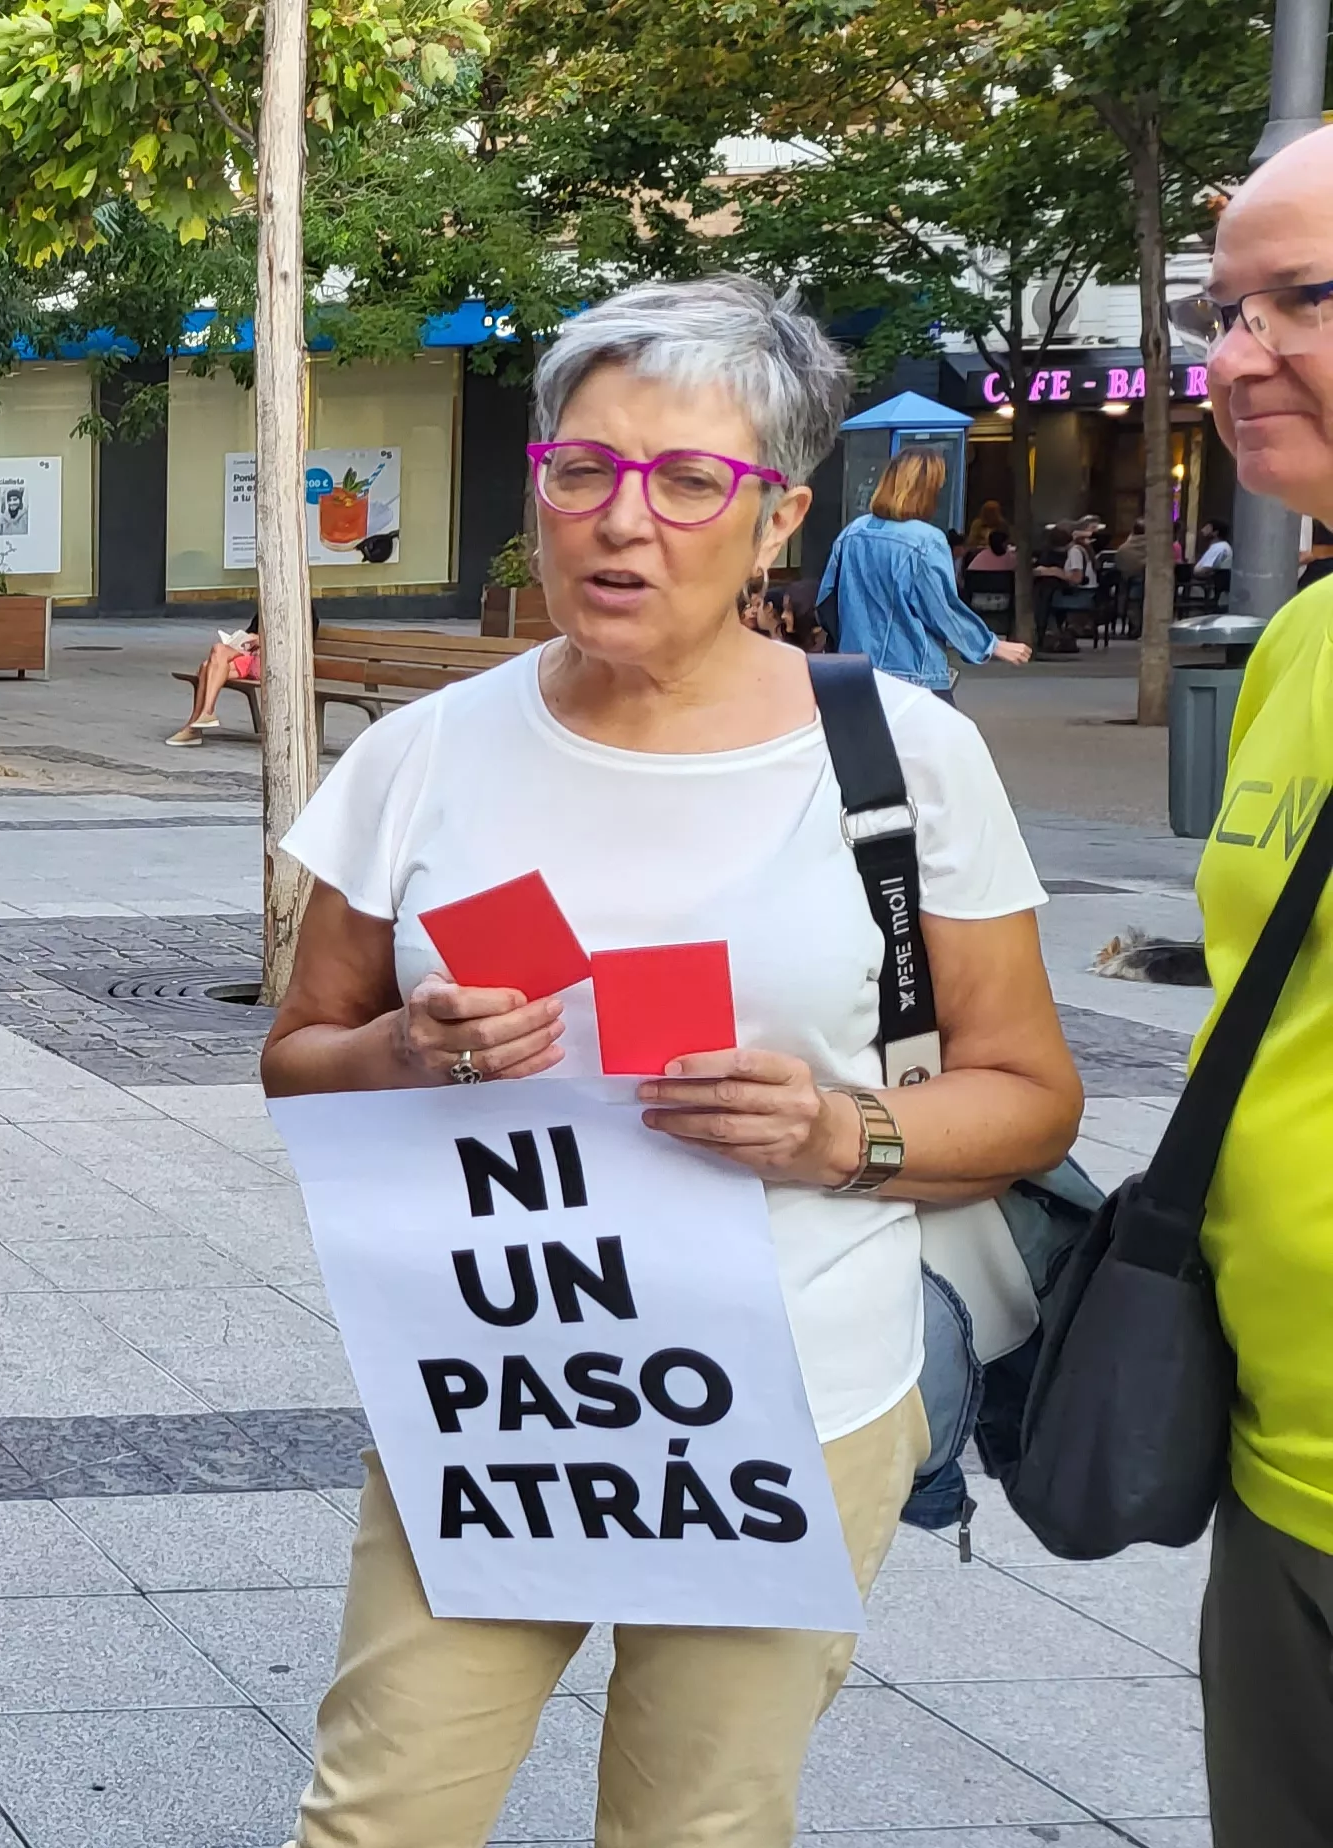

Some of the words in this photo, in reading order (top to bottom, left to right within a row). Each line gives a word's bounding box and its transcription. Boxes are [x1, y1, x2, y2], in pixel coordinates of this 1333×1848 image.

[983, 370, 1072, 404] CFE
[880, 875, 910, 936] moll
[454, 1124, 589, 1218] NI
[451, 1234, 639, 1328] UN
[417, 1346, 735, 1434] PASO
[439, 1437, 809, 1545] ATRÁS
